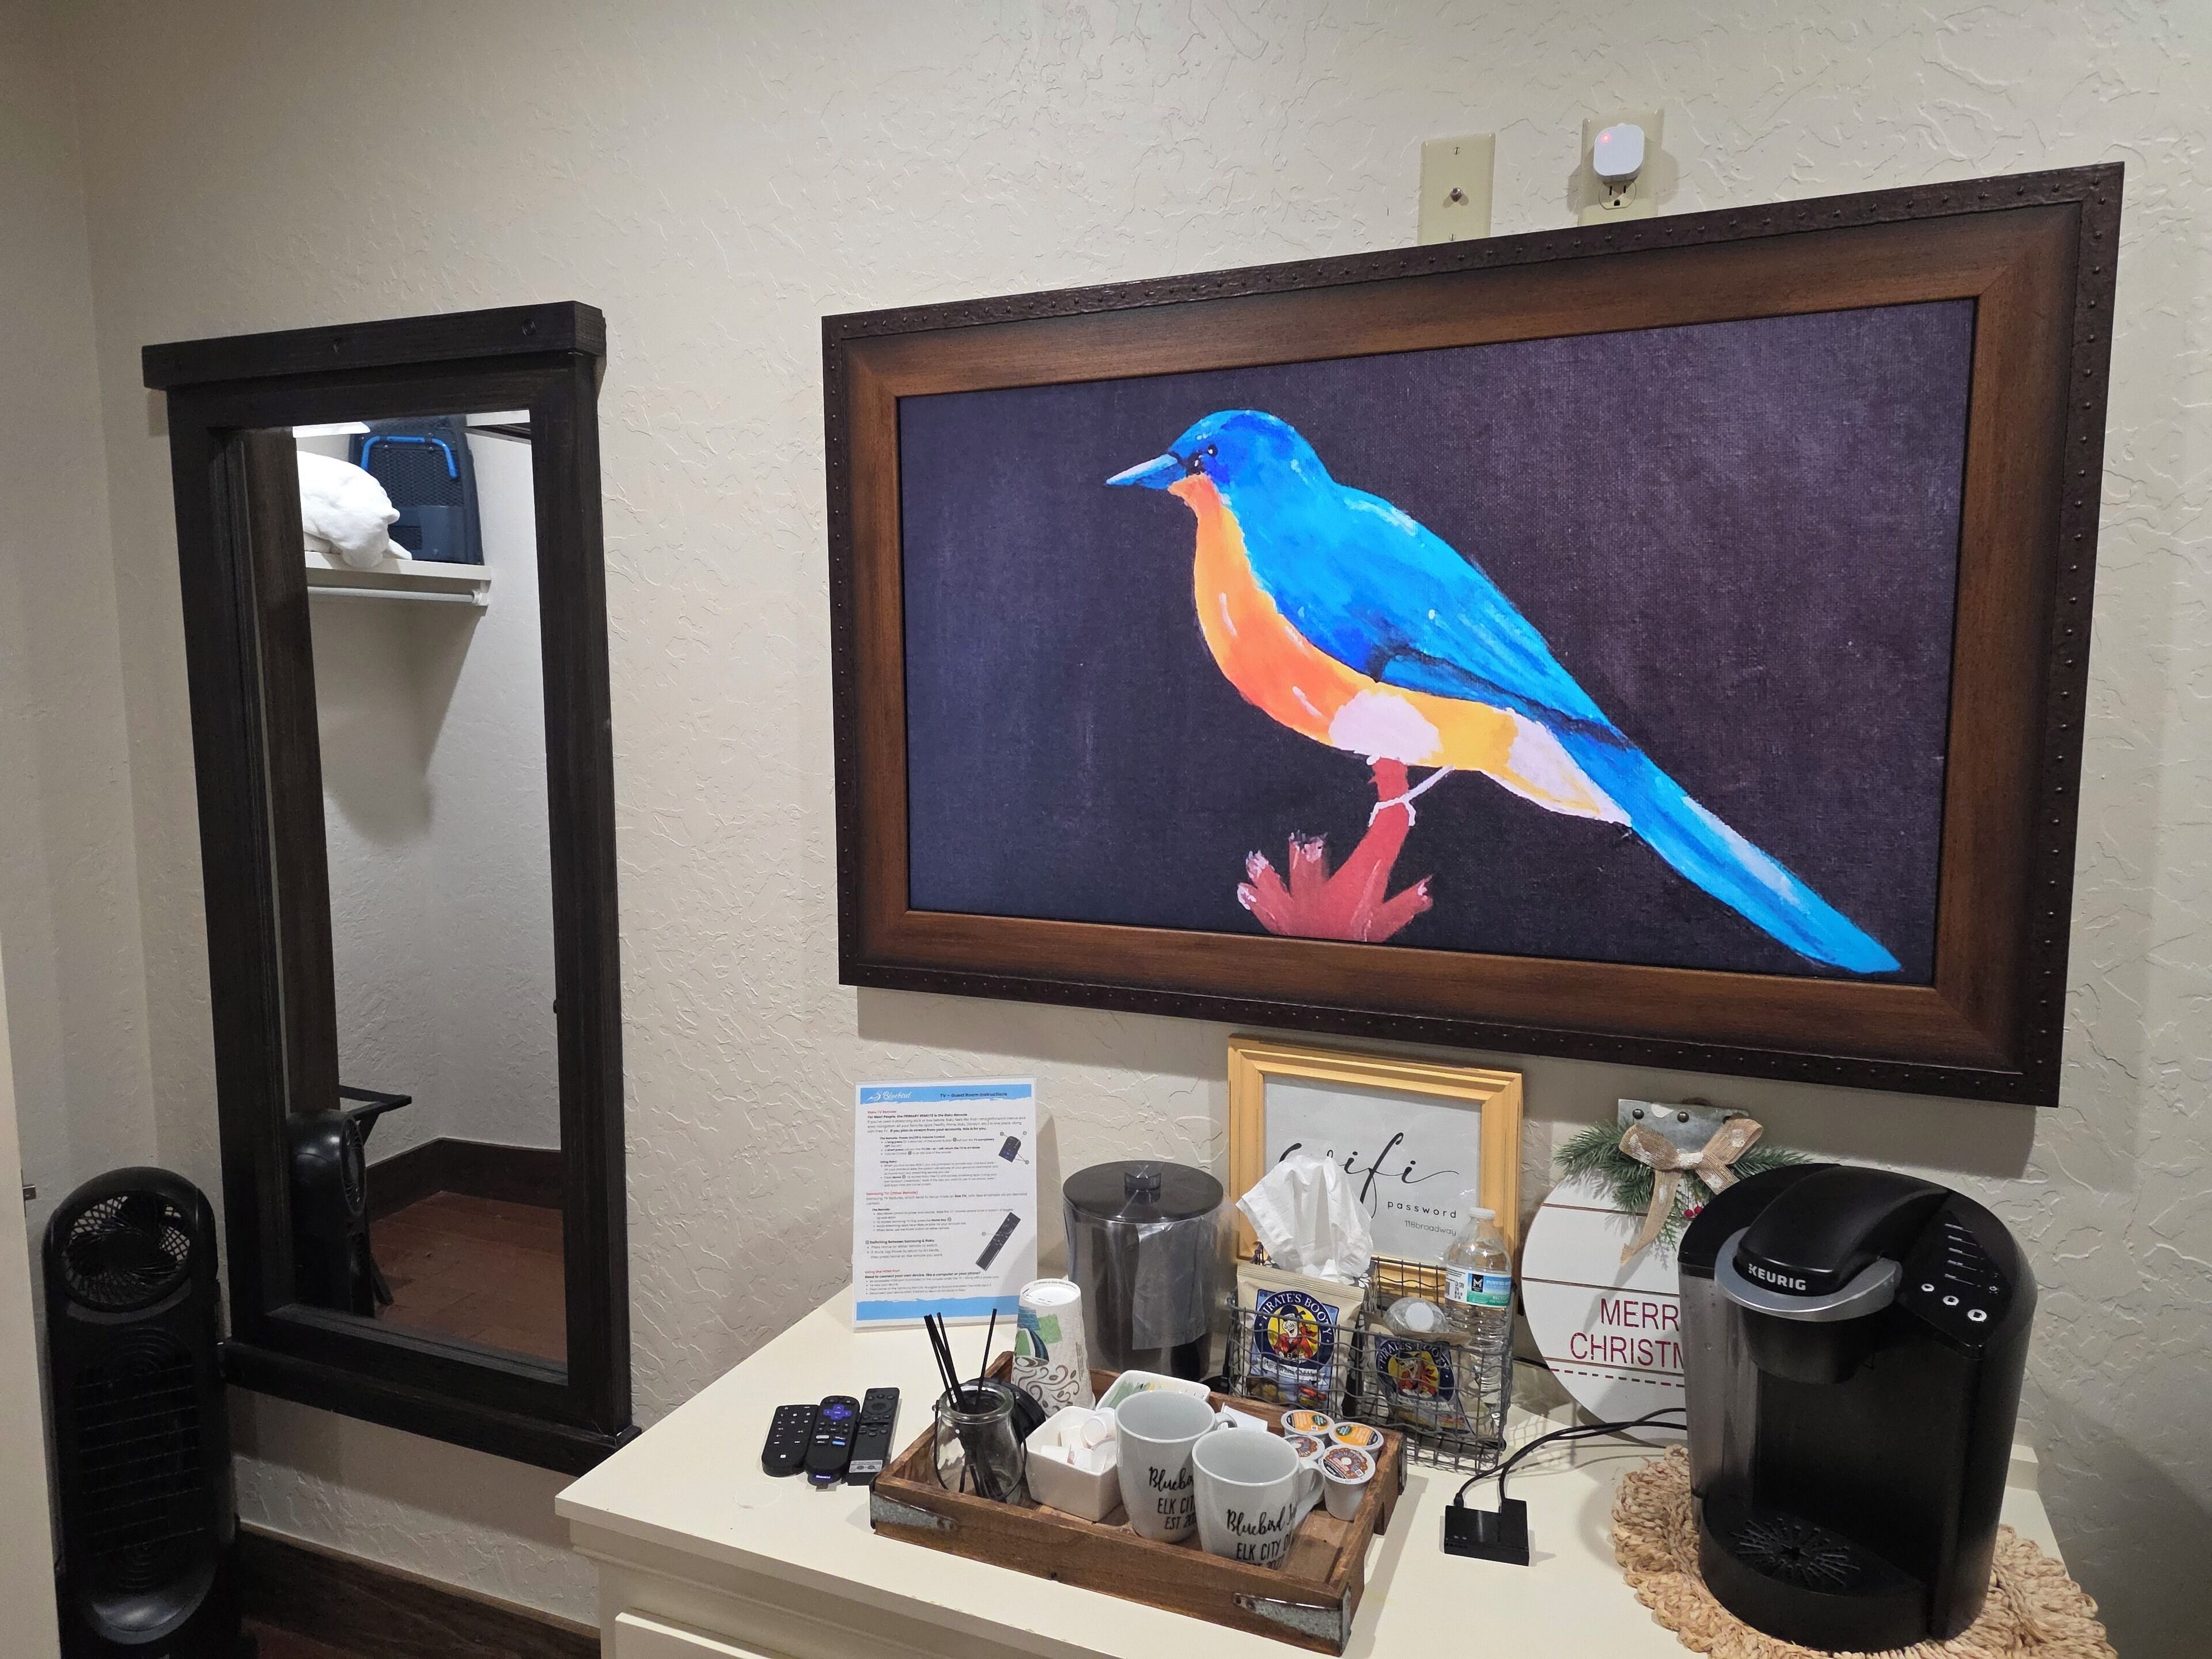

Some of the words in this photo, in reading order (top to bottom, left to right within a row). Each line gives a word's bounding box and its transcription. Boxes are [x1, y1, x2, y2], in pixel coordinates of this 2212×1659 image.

[882, 1091, 912, 1100] Bluebird
[1278, 1132, 1460, 1219] ifi
[1387, 1200, 1457, 1219] password
[1404, 1219, 1457, 1237] 118broadway
[1748, 1263, 1806, 1291] KEURIG
[1601, 1298, 1680, 1332] MERR
[1570, 1332, 1684, 1369] CHRIST
[1149, 1466, 1194, 1491] Bluebi
[1157, 1498, 1176, 1514] ELK
[1180, 1495, 1195, 1514] CIT
[1164, 1516, 1181, 1530] EST
[1183, 1512, 1196, 1528] 20
[1226, 1505, 1286, 1536] Bluebird
[1236, 1542, 1256, 1561] ELK
[1260, 1538, 1282, 1561] CITY
